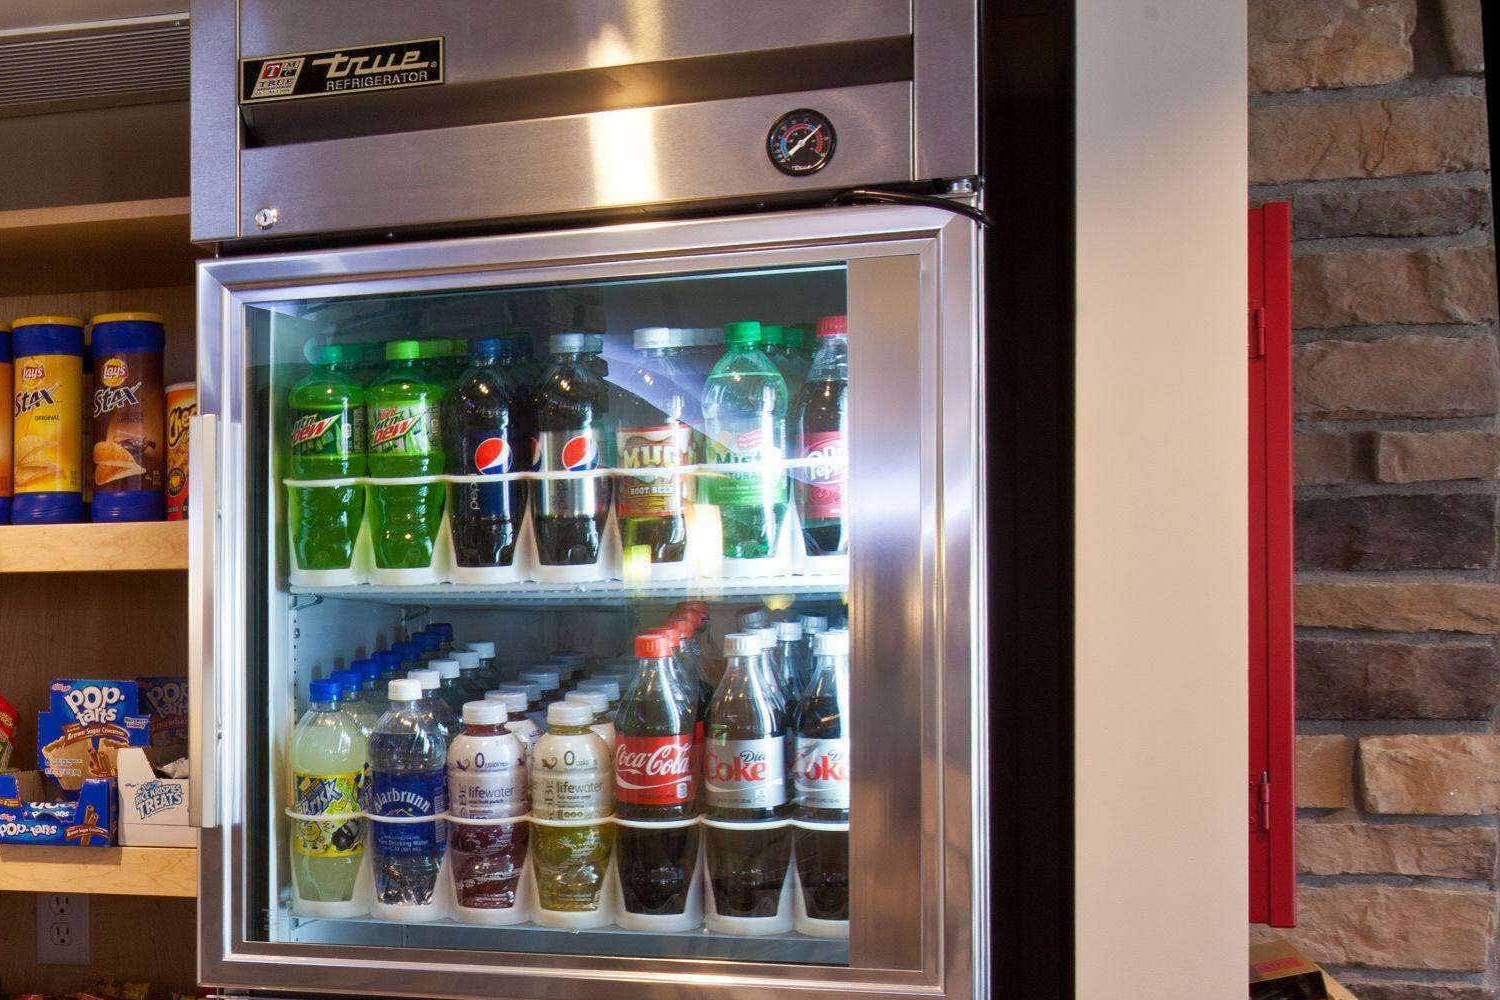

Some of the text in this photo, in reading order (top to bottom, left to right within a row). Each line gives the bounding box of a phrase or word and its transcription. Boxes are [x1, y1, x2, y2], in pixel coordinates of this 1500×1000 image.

[325, 70, 428, 91] REFRIGERATOR
[474, 752, 509, 769] 0 calories
[564, 750, 575, 766] 0
[615, 742, 691, 776] Coca-Cola
[468, 785, 514, 799] lifewater
[556, 781, 603, 794] lifewater
[136, 793, 183, 819] TREATS
